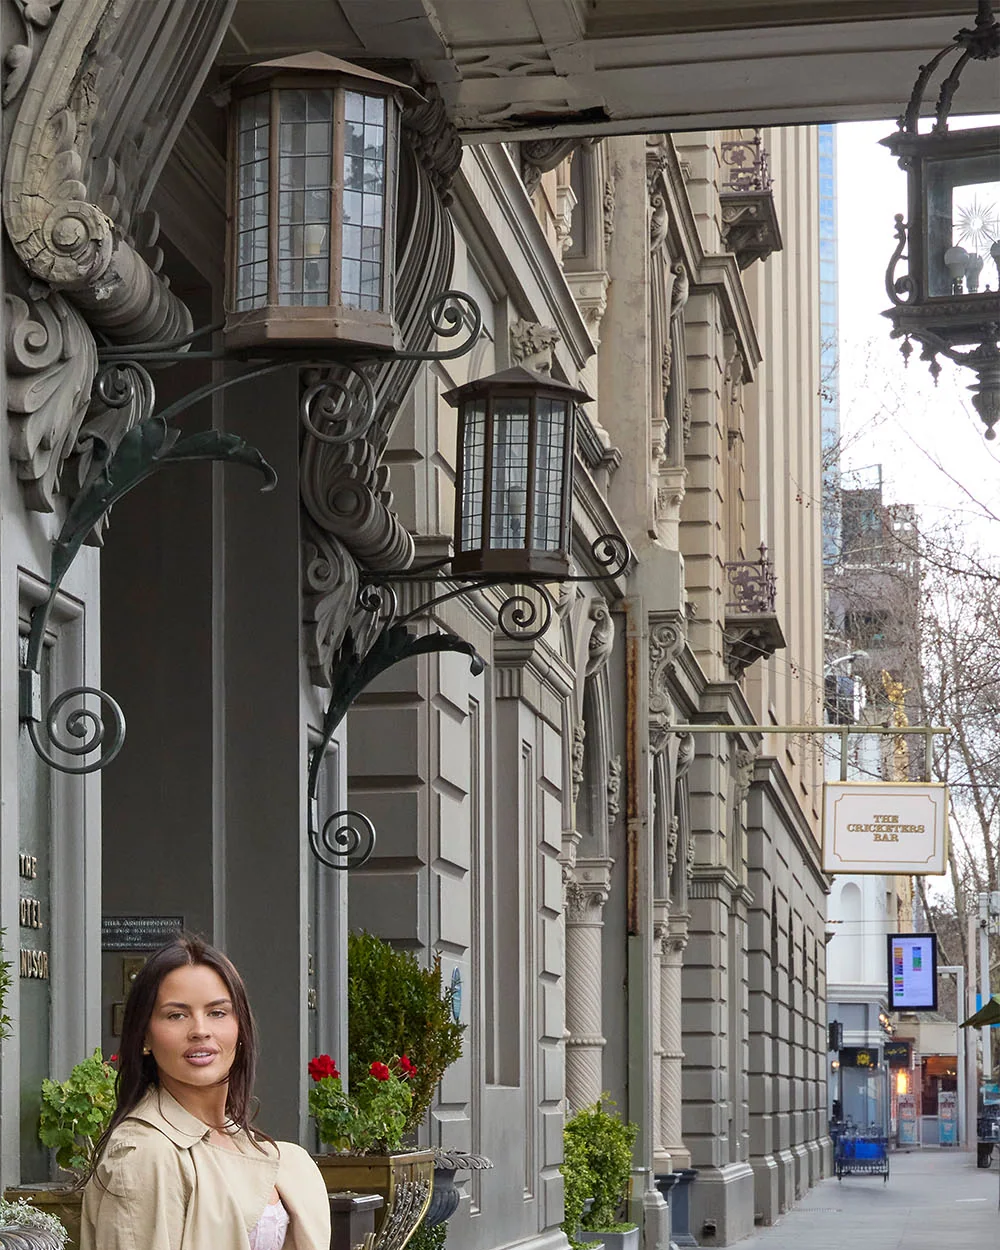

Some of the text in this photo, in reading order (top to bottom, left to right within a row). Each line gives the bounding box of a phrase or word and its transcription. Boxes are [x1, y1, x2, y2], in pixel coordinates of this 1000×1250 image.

[873, 815, 899, 823] THE
[847, 824, 925, 833] CRICKETERS
[873, 834, 899, 842] BAR
[20, 854, 37, 878] THE
[20, 898, 43, 929] OTEL
[20, 949, 49, 979] NDSOR
